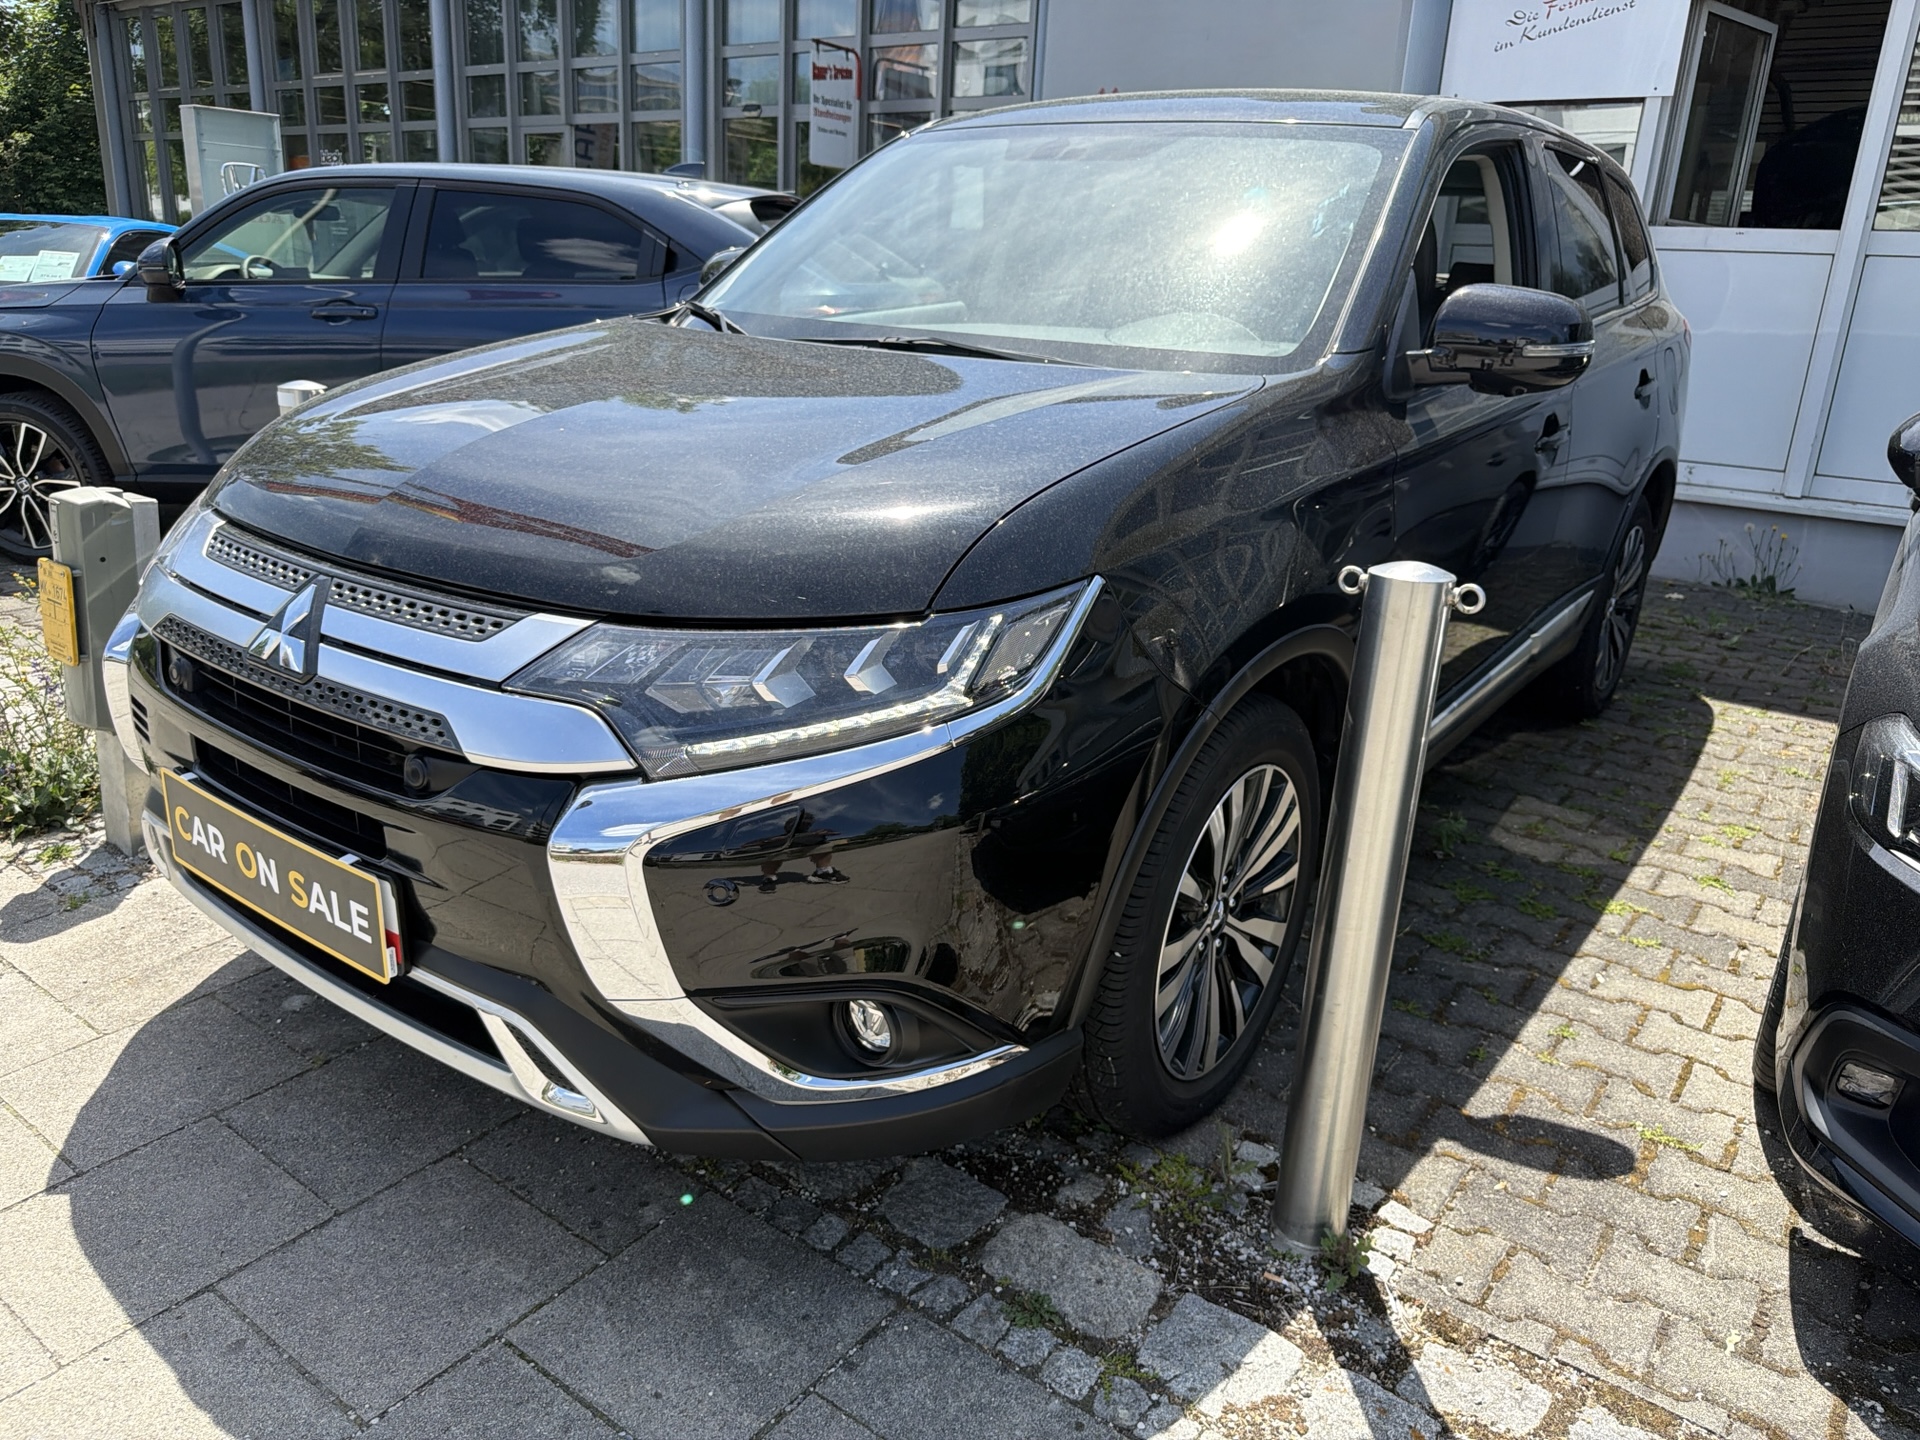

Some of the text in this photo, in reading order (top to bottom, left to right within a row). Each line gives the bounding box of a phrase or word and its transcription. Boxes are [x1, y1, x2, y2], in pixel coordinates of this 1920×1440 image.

[1494, 0, 1637, 53] im Kundendienst
[1505, 10, 1539, 27] Die
[174, 806, 373, 944] CAR ON SALE
